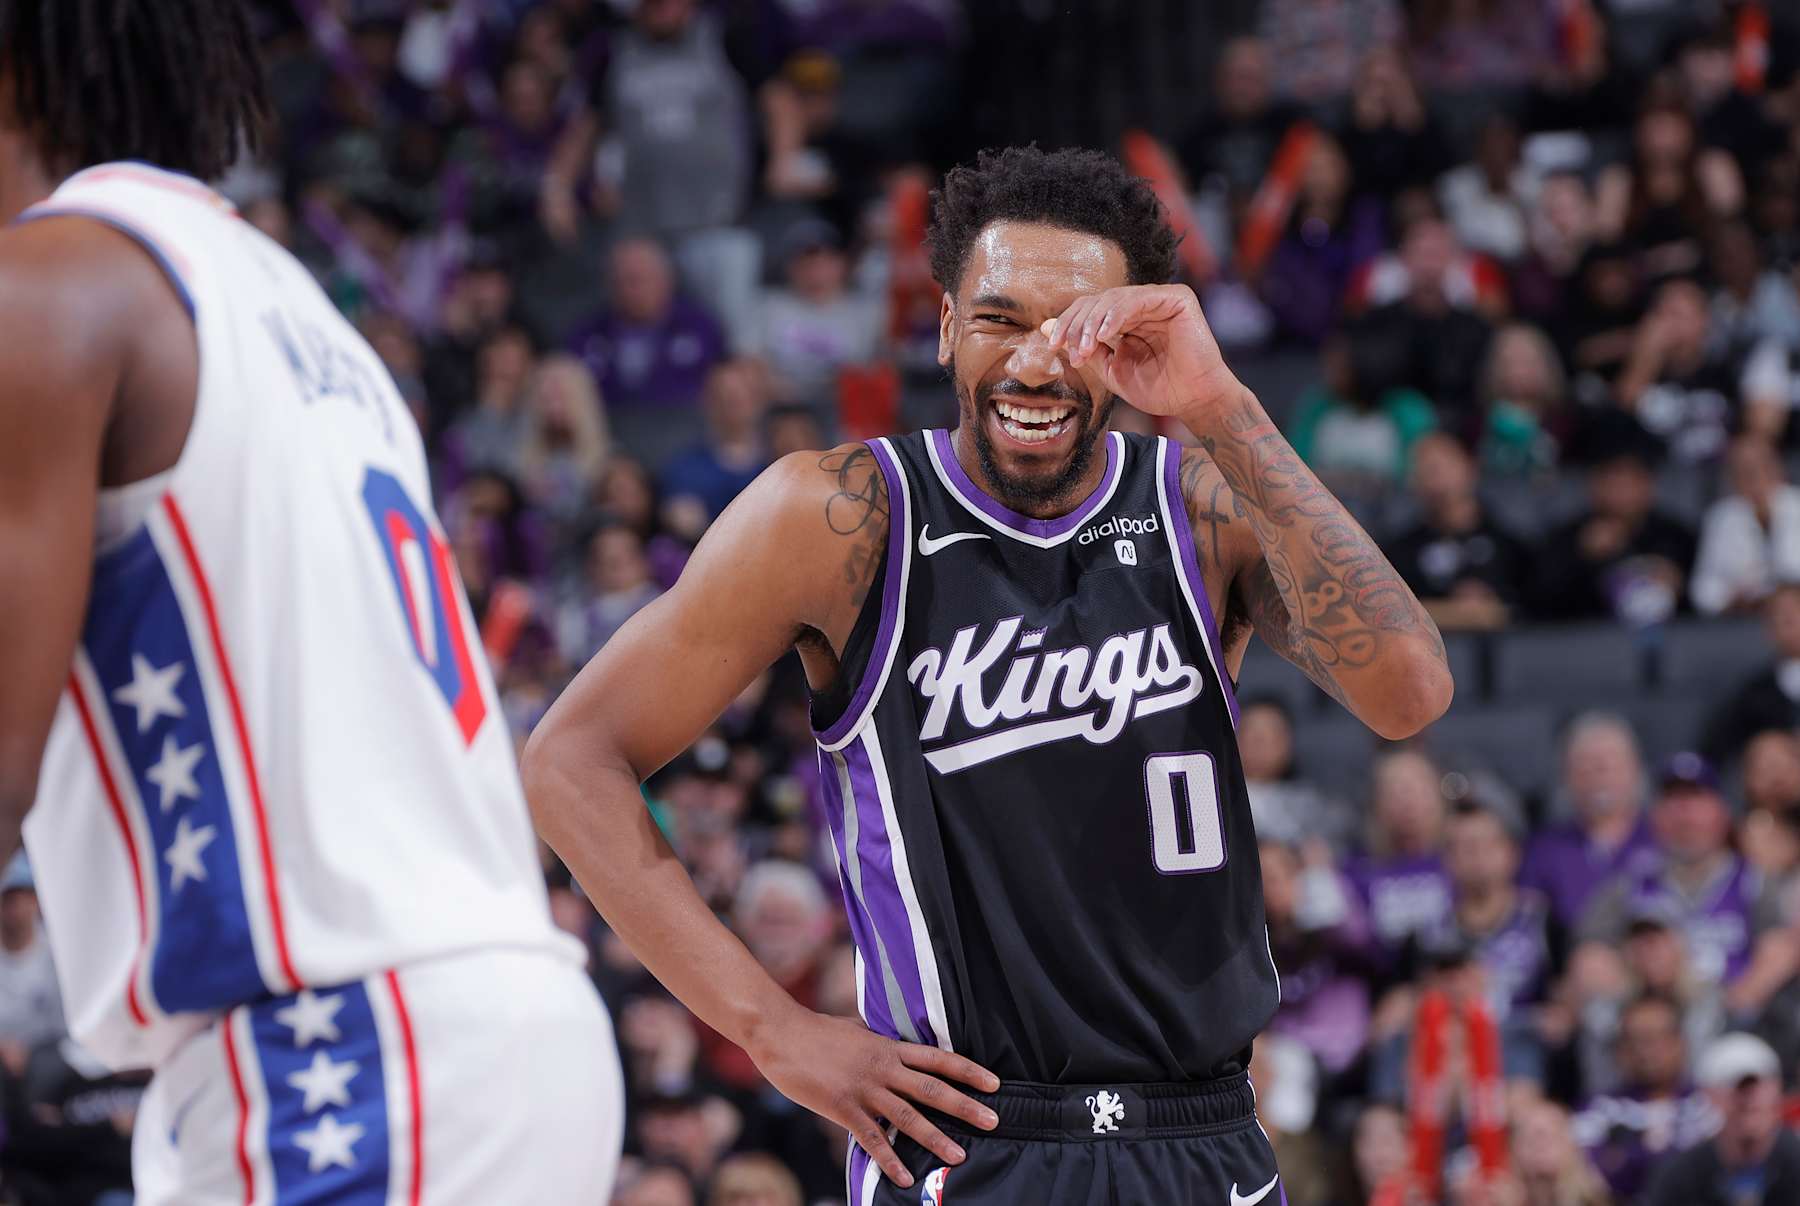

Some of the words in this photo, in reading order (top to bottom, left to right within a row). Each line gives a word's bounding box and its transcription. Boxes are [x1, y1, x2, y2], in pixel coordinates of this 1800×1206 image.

[1078, 513, 1160, 545] dialpad
[361, 464, 488, 750] 0
[906, 614, 1204, 775] Kings
[1143, 751, 1227, 875] 0
